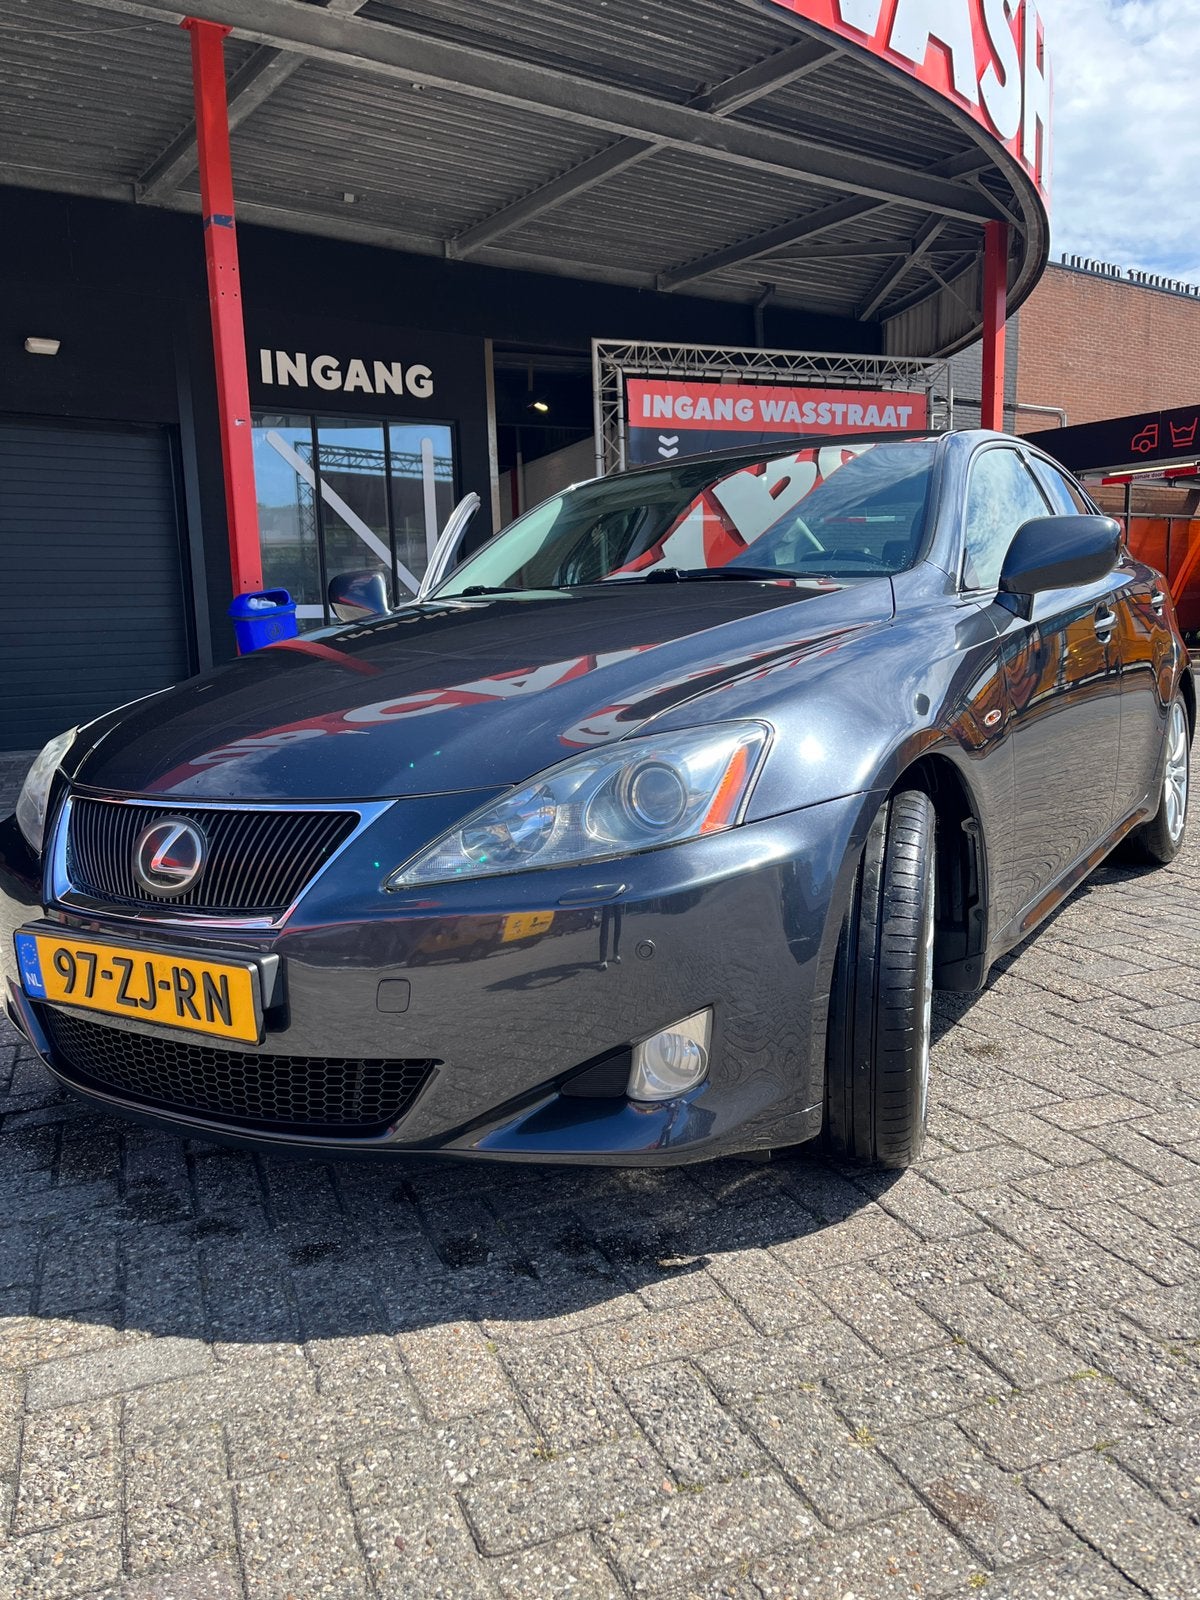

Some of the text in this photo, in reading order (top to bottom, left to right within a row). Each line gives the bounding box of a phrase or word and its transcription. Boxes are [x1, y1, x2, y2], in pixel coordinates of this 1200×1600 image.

[260, 349, 433, 398] INGANG
[642, 394, 913, 427] INGANG WASSTRAAT
[26, 971, 42, 988] NL
[53, 947, 233, 1027] 97-ZJ-RN
